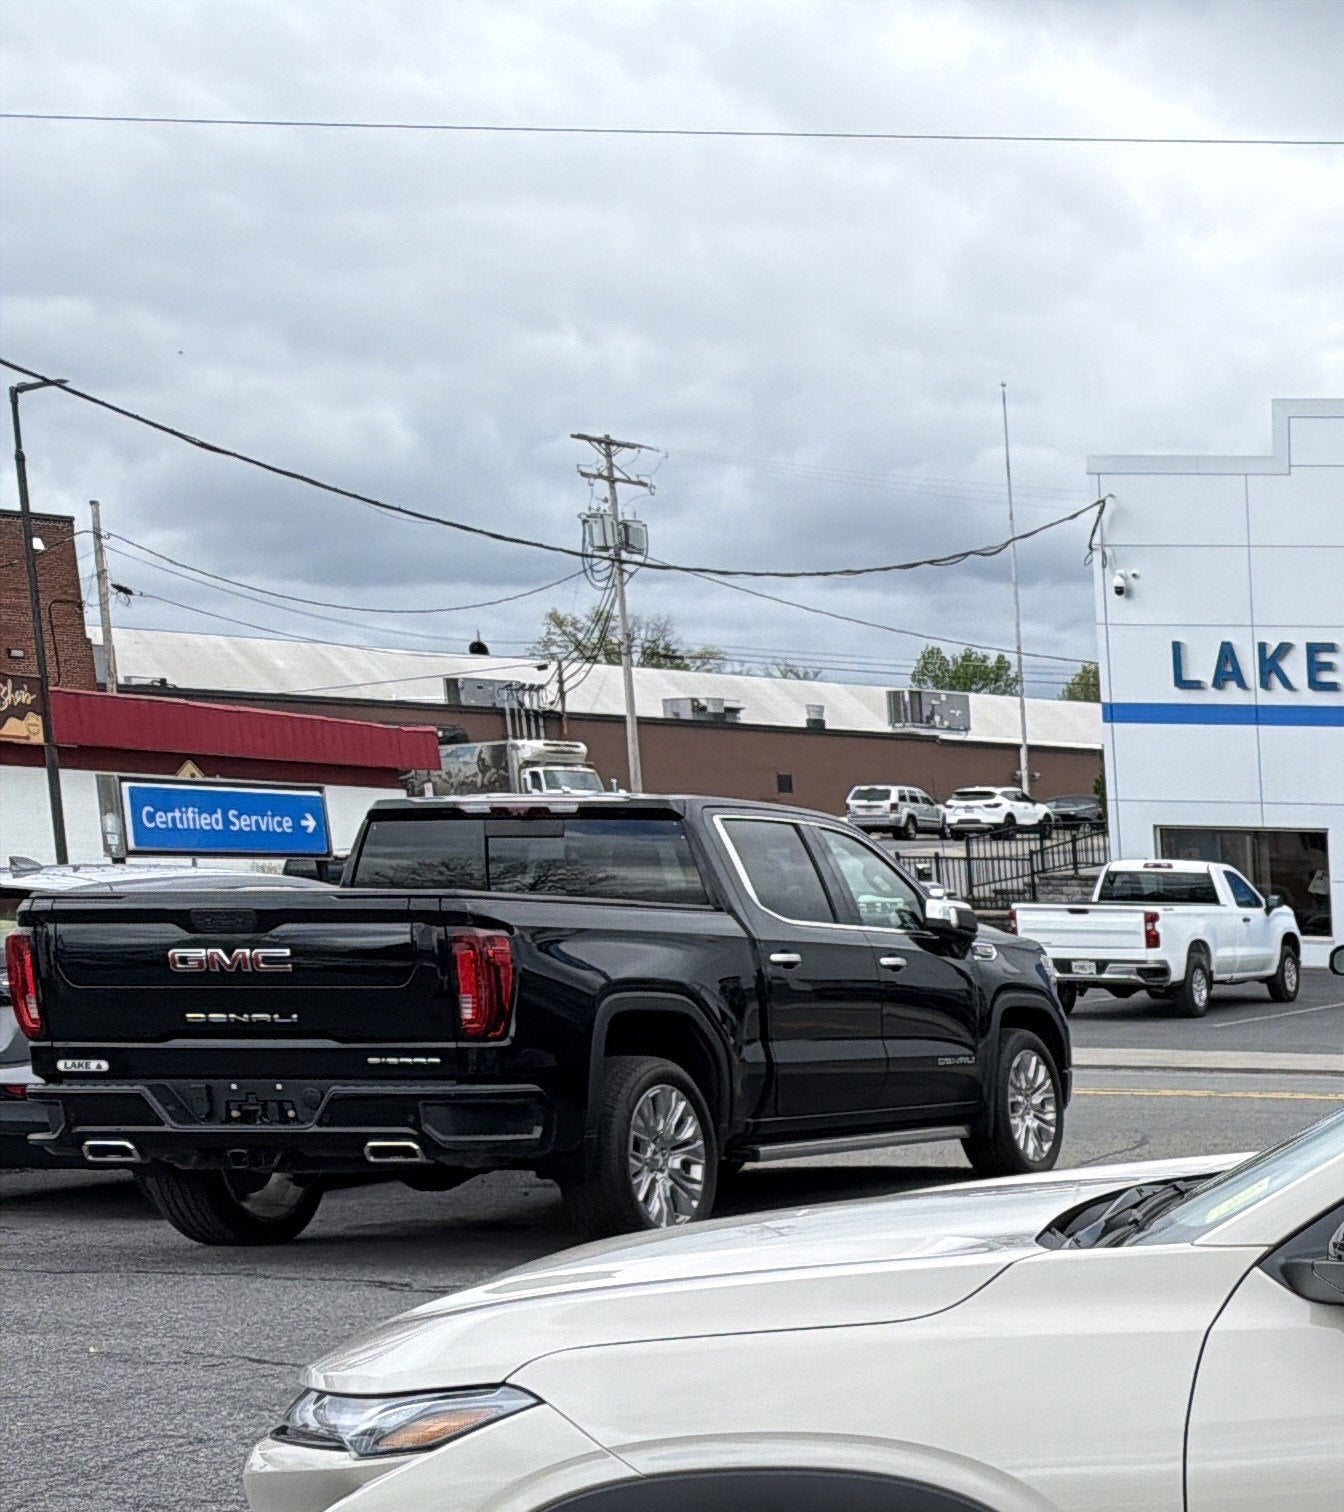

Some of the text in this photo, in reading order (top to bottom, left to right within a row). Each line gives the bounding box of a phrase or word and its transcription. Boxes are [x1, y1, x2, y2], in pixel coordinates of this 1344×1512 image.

[1171, 641, 1342, 692] LAKE
[141, 805, 293, 833] Certified Service
[168, 948, 293, 973] GMC
[185, 1013, 298, 1022] DENALI
[64, 1061, 91, 1070] LAKE
